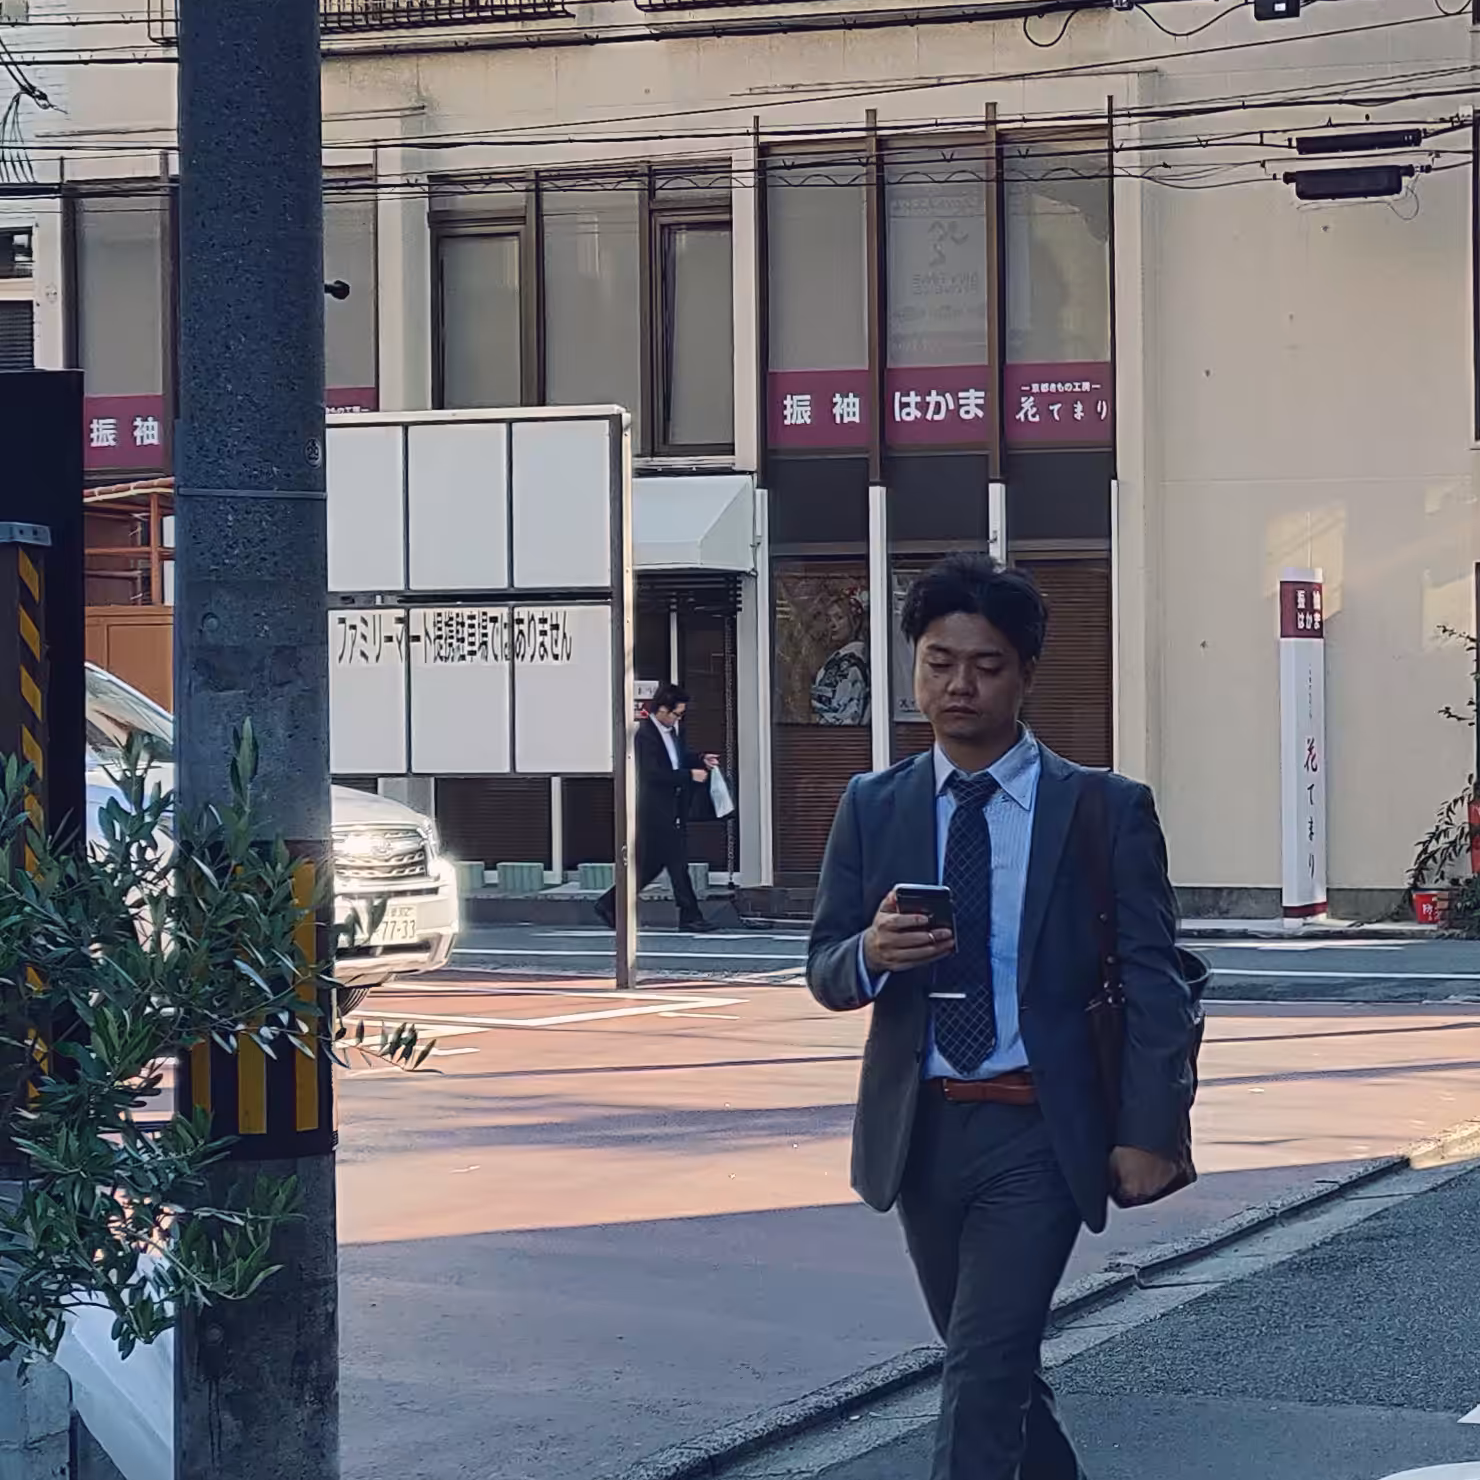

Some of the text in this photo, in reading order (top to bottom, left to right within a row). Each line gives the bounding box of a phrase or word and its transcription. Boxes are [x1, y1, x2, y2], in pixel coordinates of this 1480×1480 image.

[784, 393, 860, 425] 振袖
[894, 389, 985, 422] はかま
[1015, 396, 1107, 422] 花てまり
[90, 417, 161, 447] 振袖
[338, 610, 573, 664] ファミリーマート提携駐車場ではありません
[1304, 737, 1318, 880] 花てまり
